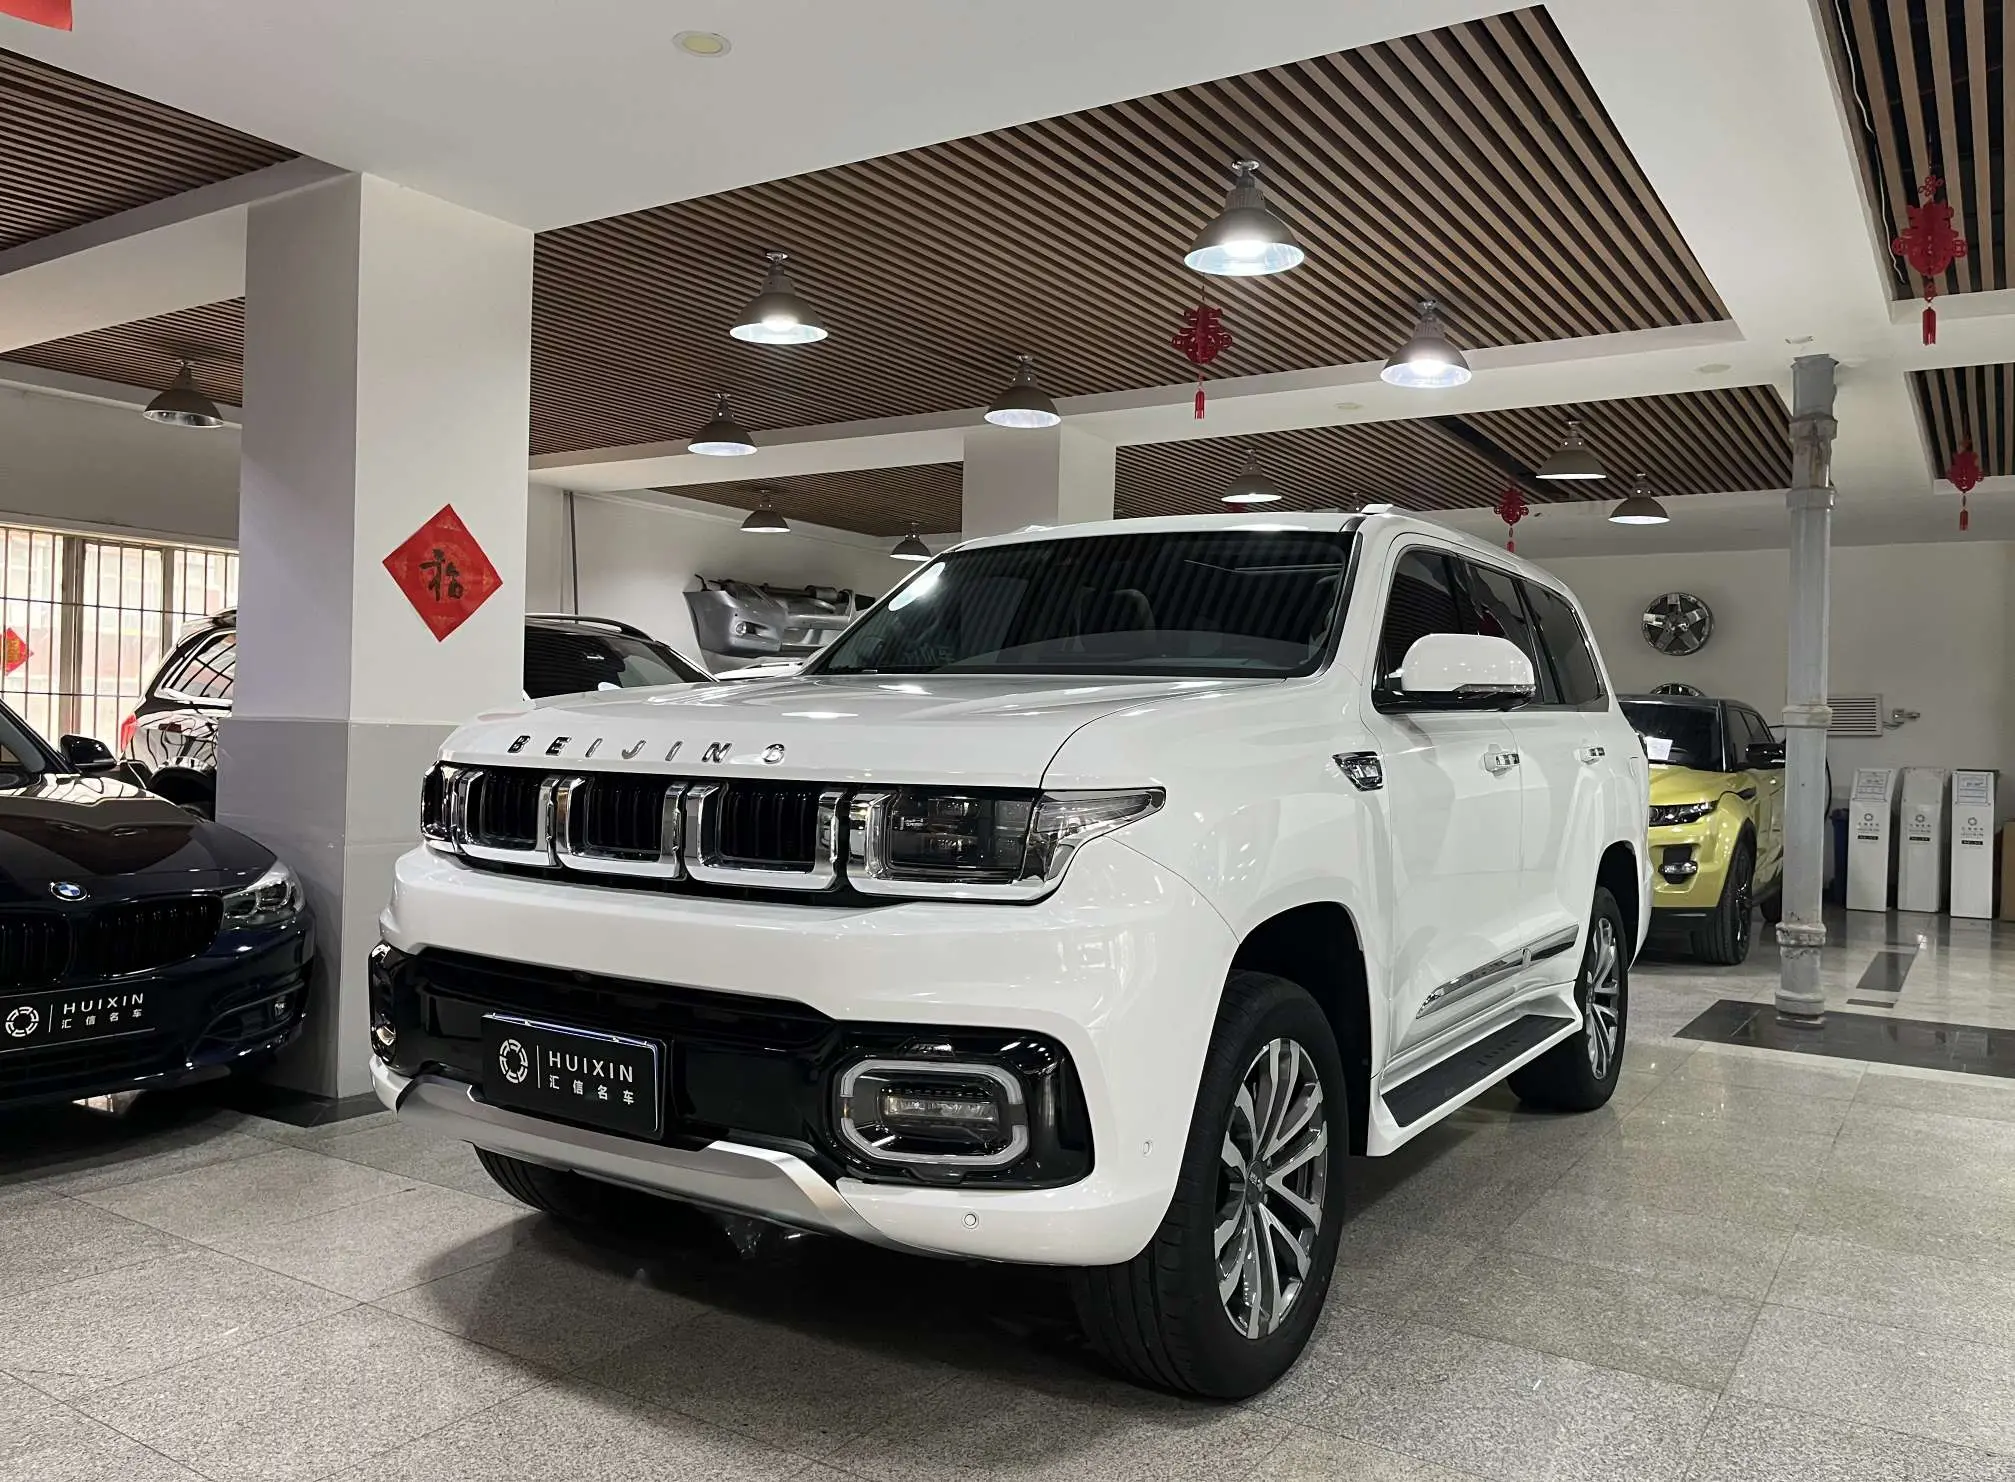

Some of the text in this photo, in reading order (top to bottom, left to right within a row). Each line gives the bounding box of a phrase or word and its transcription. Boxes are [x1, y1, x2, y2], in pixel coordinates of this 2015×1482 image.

[507, 734, 786, 765] BEIJING
[61, 1008, 142, 1030] 汇信名车
[63, 993, 144, 1015] HUIXIN
[549, 1050, 633, 1083] HUIXIN
[549, 1074, 635, 1105] 汇信名车
